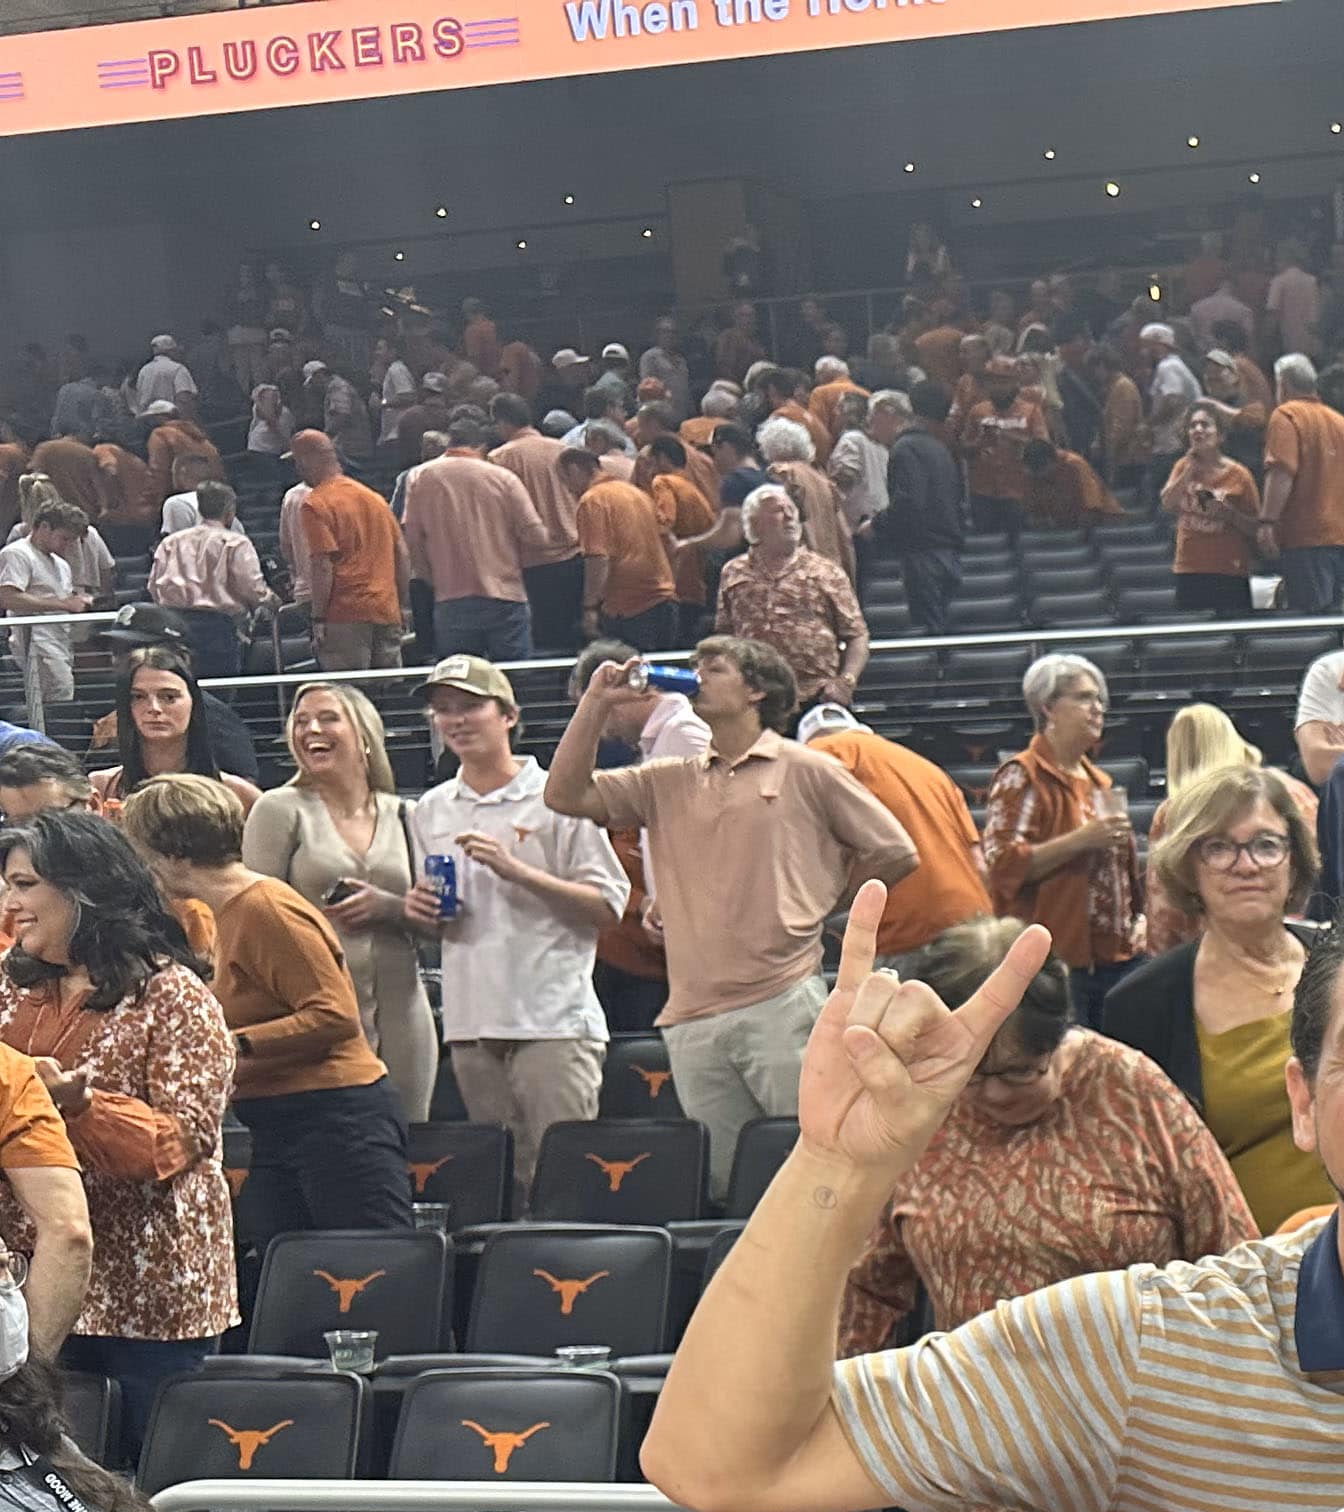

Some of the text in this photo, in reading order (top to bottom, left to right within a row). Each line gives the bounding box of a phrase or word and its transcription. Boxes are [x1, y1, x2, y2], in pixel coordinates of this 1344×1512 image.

[565, 0, 699, 42] When
[713, 0, 790, 26] the
[148, 17, 466, 90] PLUCKERS
[45, 1473, 74, 1502] MOOD
